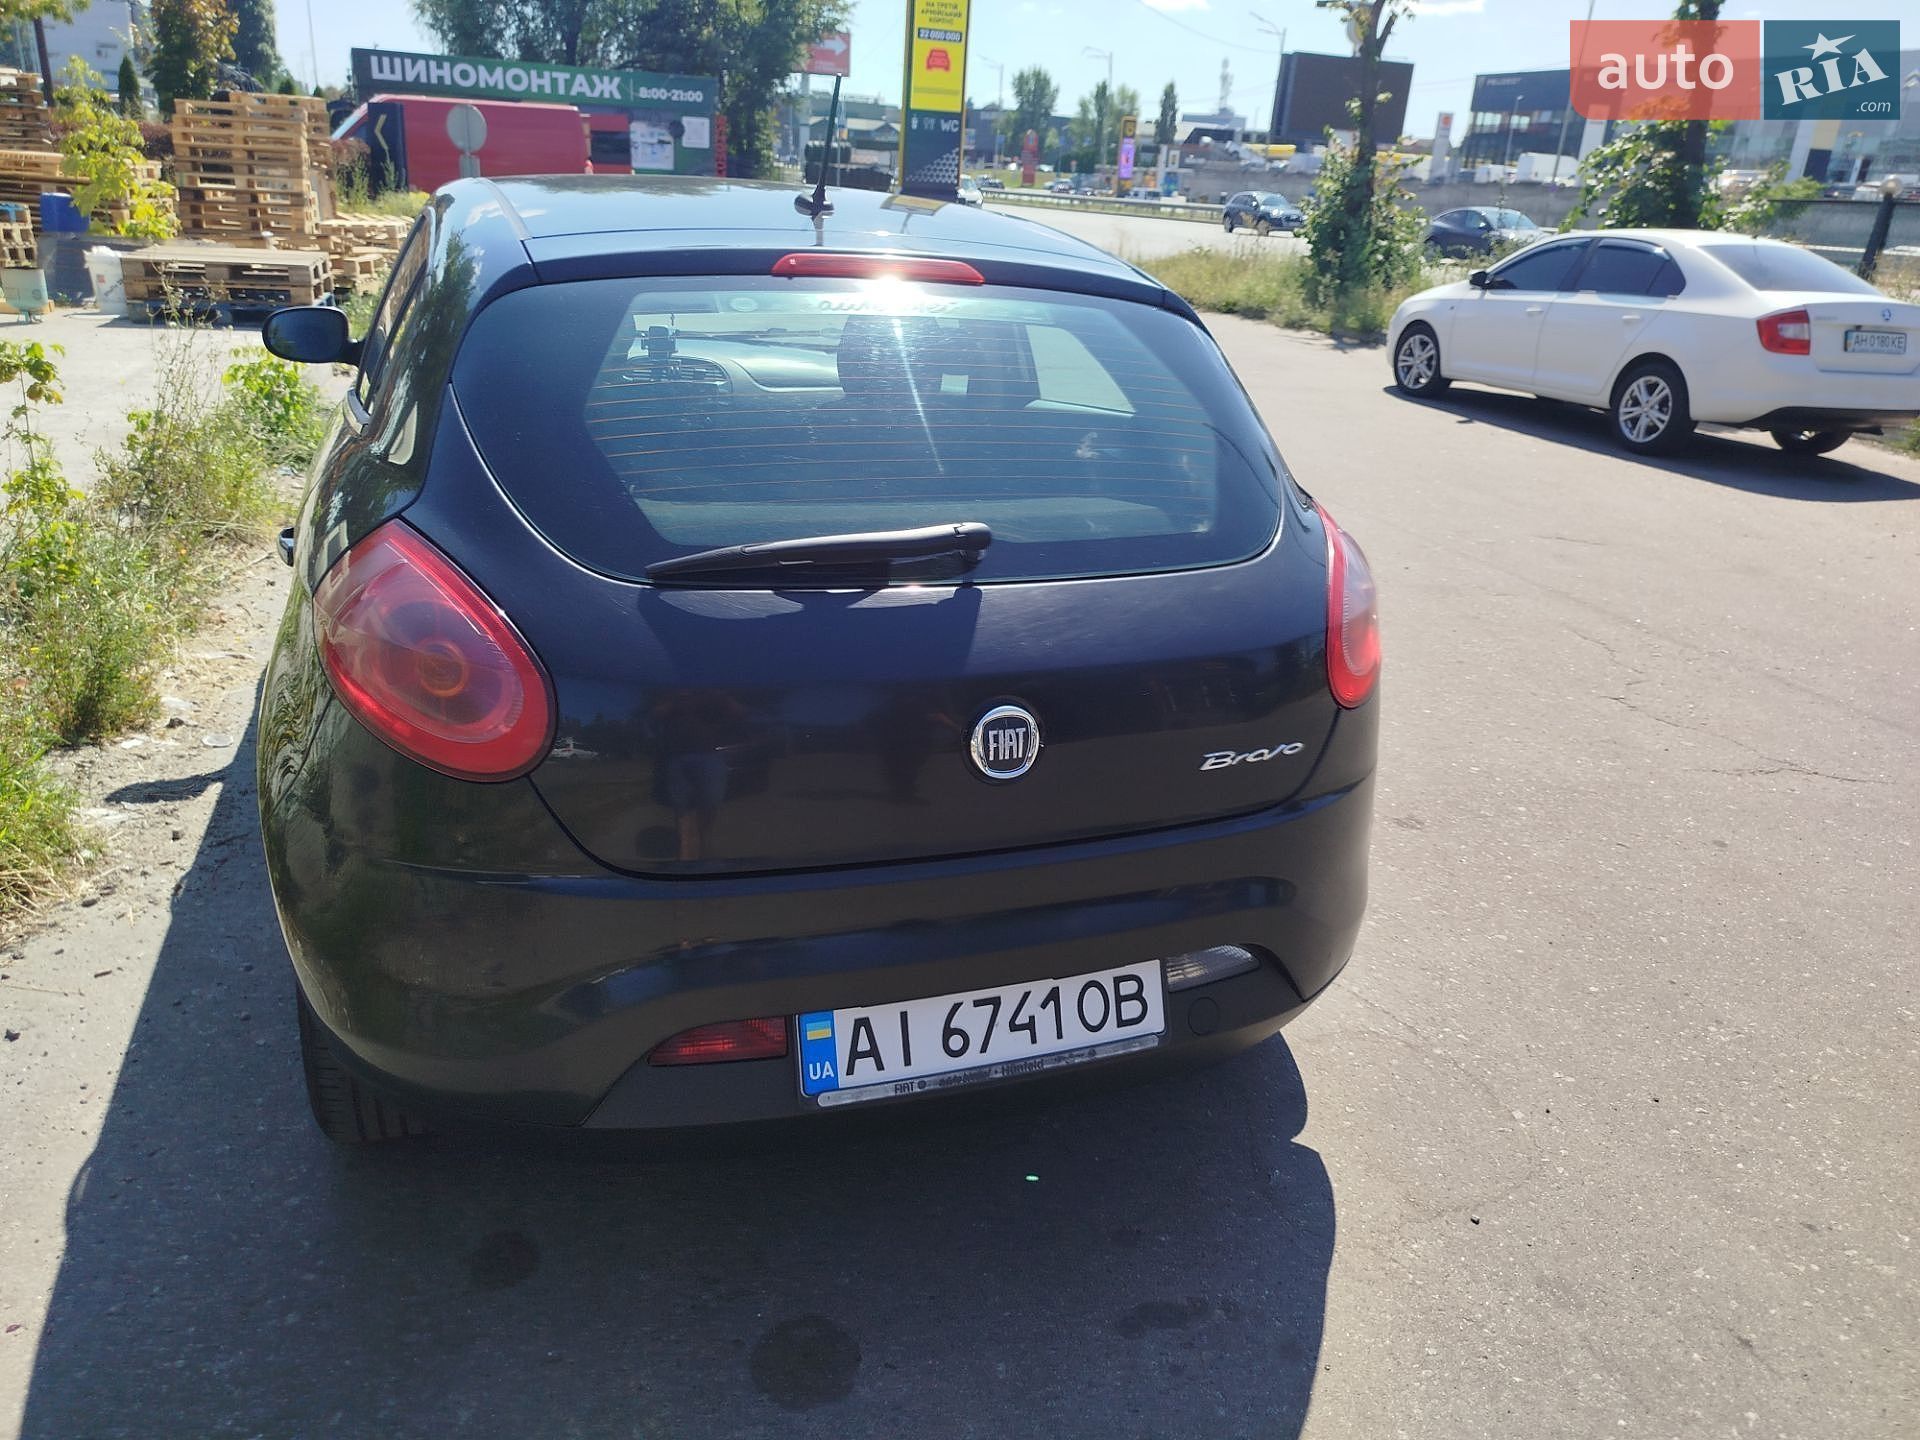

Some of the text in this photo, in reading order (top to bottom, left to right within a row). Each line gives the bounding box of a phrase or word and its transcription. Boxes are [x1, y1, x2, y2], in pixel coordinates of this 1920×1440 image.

[369, 55, 703, 102] ШИНОМОНТАЖ 8:00-21:00
[941, 119, 959, 132] WC
[987, 727, 1027, 761] FIAT
[1200, 741, 1304, 771] Bravo
[845, 1011, 912, 1076] AI
[808, 1061, 835, 1081] UA
[894, 1080, 915, 1094] FIAT
